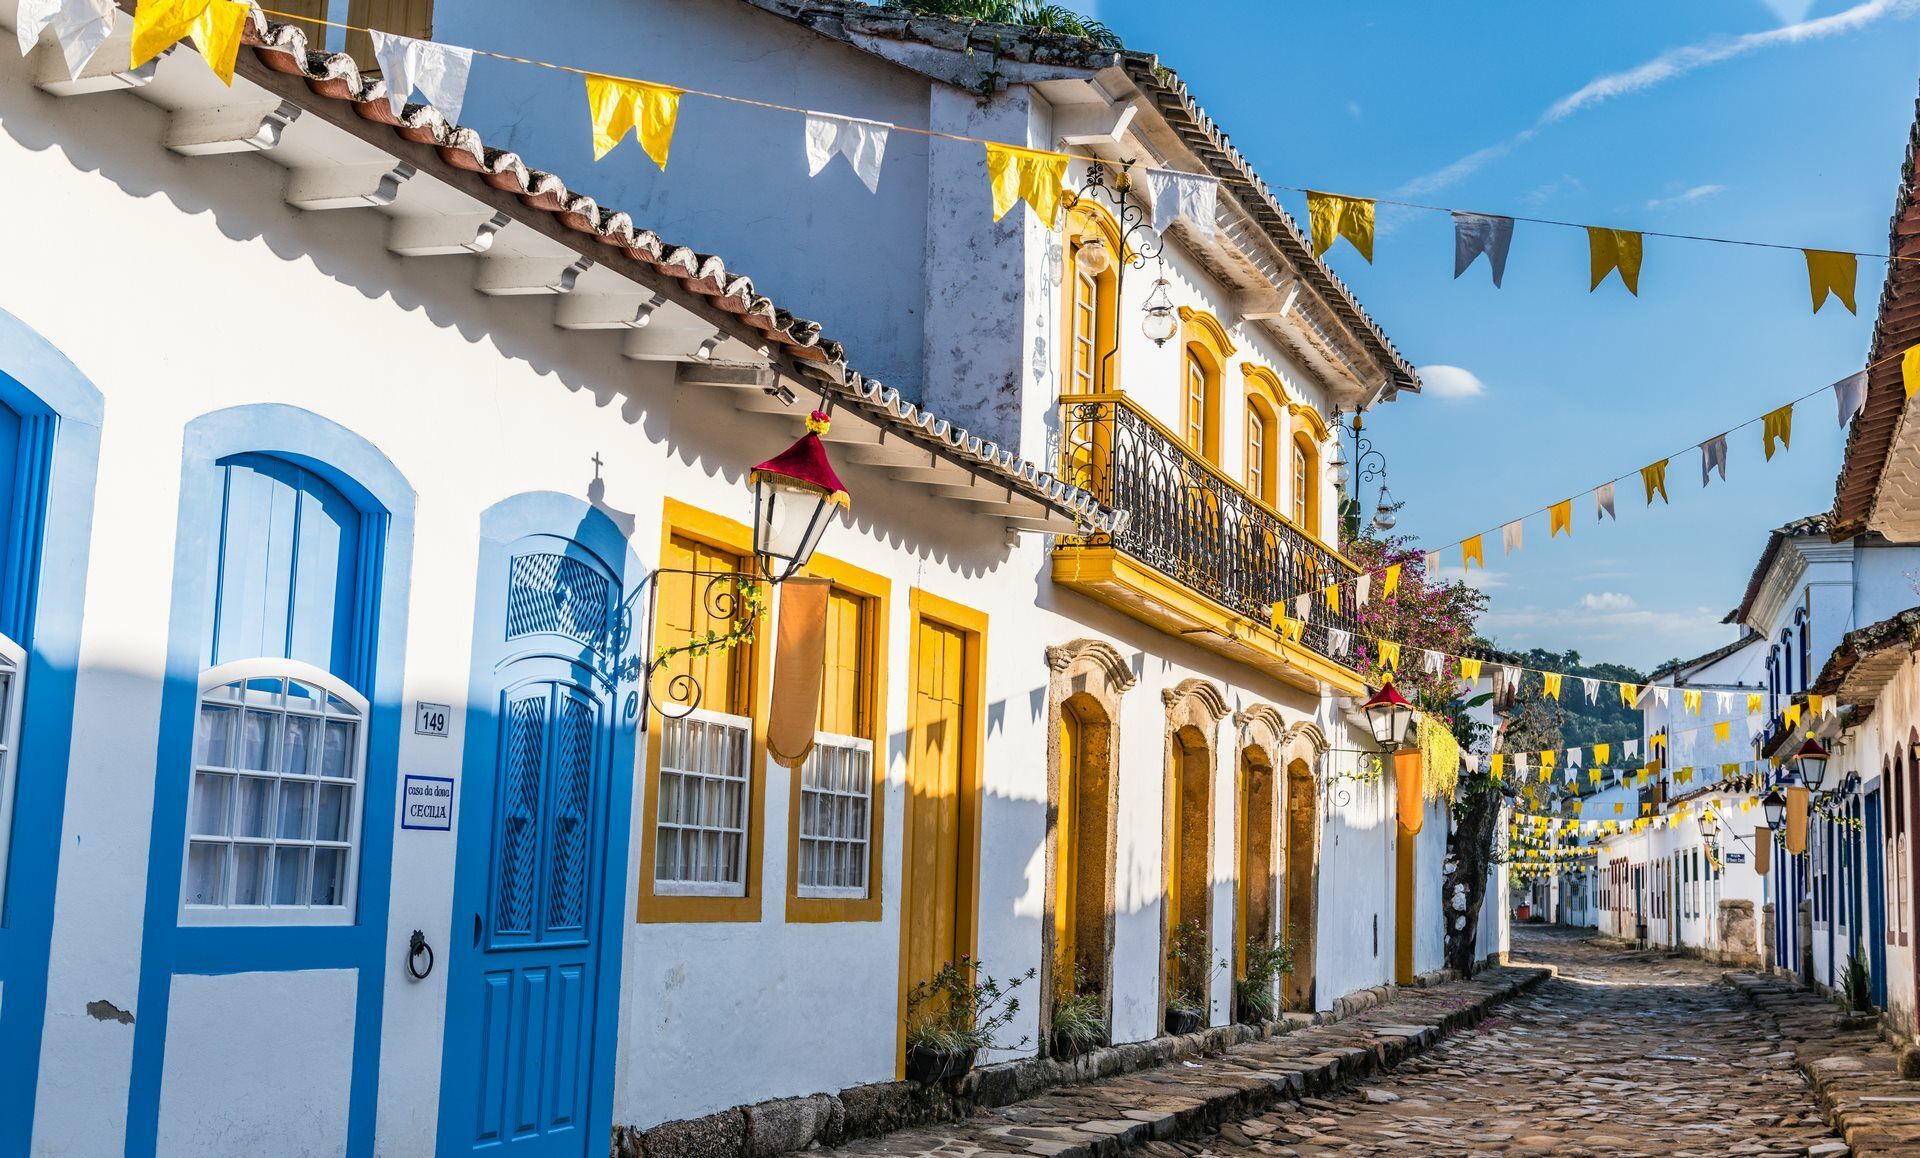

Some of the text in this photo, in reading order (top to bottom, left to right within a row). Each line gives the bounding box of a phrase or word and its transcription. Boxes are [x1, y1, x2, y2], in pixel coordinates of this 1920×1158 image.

[423, 711, 445, 731] 149
[408, 785, 450, 797] casa da dona
[410, 804, 446, 818] CECILIA
